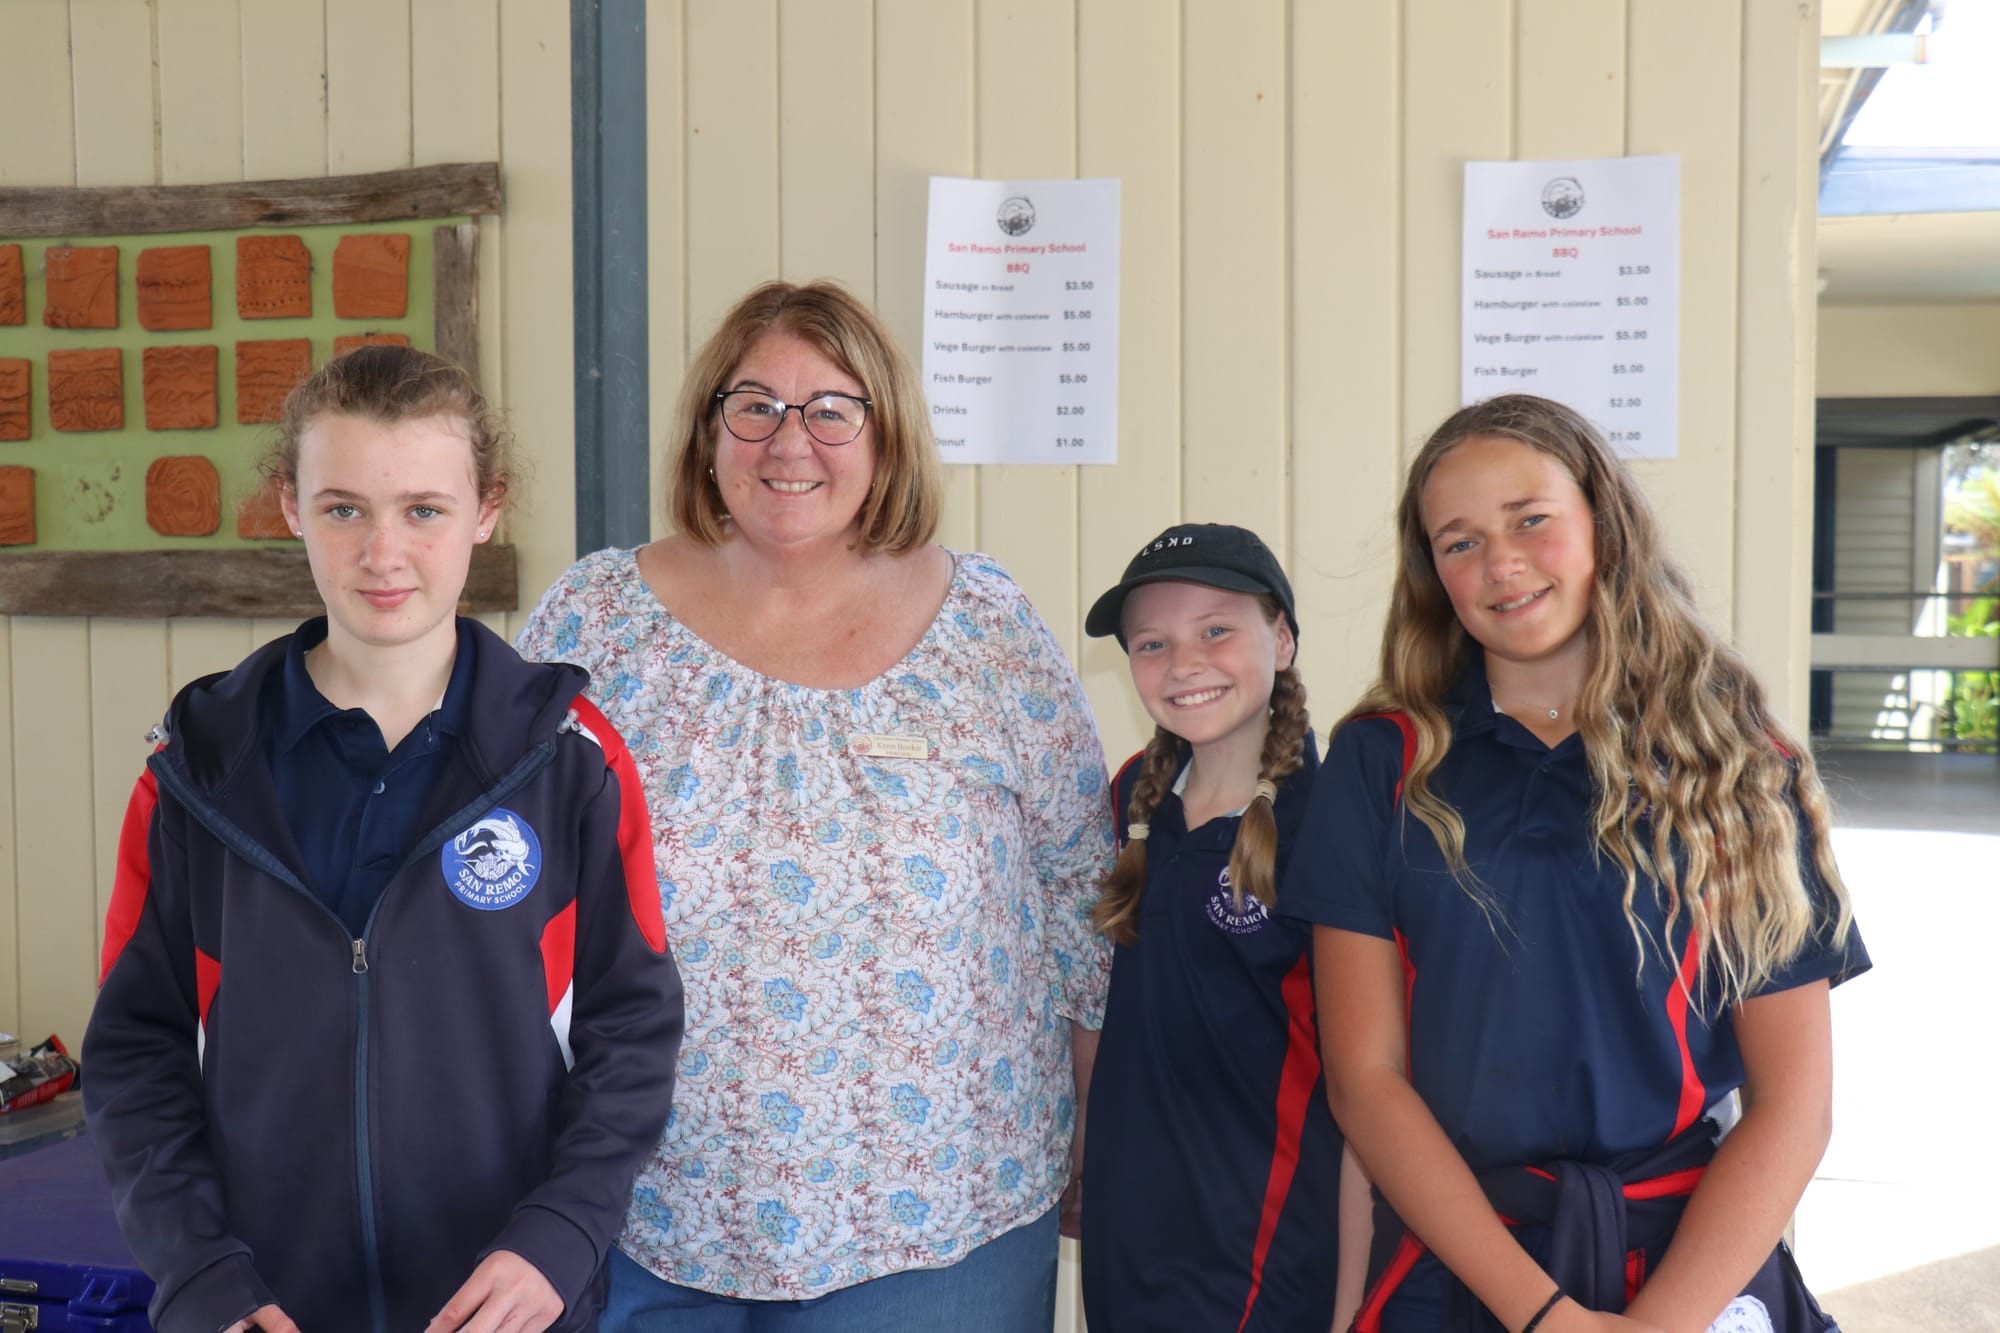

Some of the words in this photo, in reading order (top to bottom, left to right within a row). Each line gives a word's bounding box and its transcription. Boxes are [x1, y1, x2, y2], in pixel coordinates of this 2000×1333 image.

[1488, 229, 1510, 240] San
[1513, 228, 1547, 239] Remo
[1550, 228, 1597, 239] Primary
[1599, 225, 1642, 237] School
[948, 242, 969, 254] San
[971, 244, 1002, 254] Remo
[1005, 244, 1046, 256] Primary
[1049, 243, 1086, 254] School
[1552, 248, 1578, 259] BBQ
[1007, 263, 1030, 274] BBQ
[1474, 269, 1522, 280] Sausage
[1619, 265, 1650, 276] $3.50
[936, 280, 979, 293] Sausage
[1065, 280, 1093, 291] $3.50
[1474, 299, 1539, 311] Hamburger
[1616, 296, 1648, 307] $5.00
[935, 310, 993, 322] Hamburger
[1064, 310, 1091, 321] $5.00
[1474, 333, 1501, 344] Vege
[1504, 333, 1541, 344] Burger
[1616, 330, 1647, 341] $5.00
[934, 342, 960, 354] Vege
[961, 342, 996, 354] Burger
[1063, 342, 1090, 353] $5.00
[1474, 367, 1498, 376] Fish
[1500, 366, 1537, 378] Burger
[1612, 364, 1644, 374] $5.00
[934, 373, 955, 384] Fish
[958, 374, 992, 386] Burger
[1060, 374, 1087, 384] $5.00
[1610, 398, 1641, 408] $2.00
[933, 405, 967, 416] Drinks
[1057, 406, 1085, 416] $2.00
[1056, 438, 1084, 448] $1.00
[458, 868, 484, 892] SAN
[485, 871, 522, 895] REMO
[454, 881, 494, 904] PRIMARY
[494, 883, 527, 904] SCHOOL
[1210, 895, 1227, 918] SAN
[1225, 912, 1262, 927] REMO
[1205, 904, 1229, 931] PRIMARY
[1230, 924, 1263, 934] SCHOOL
